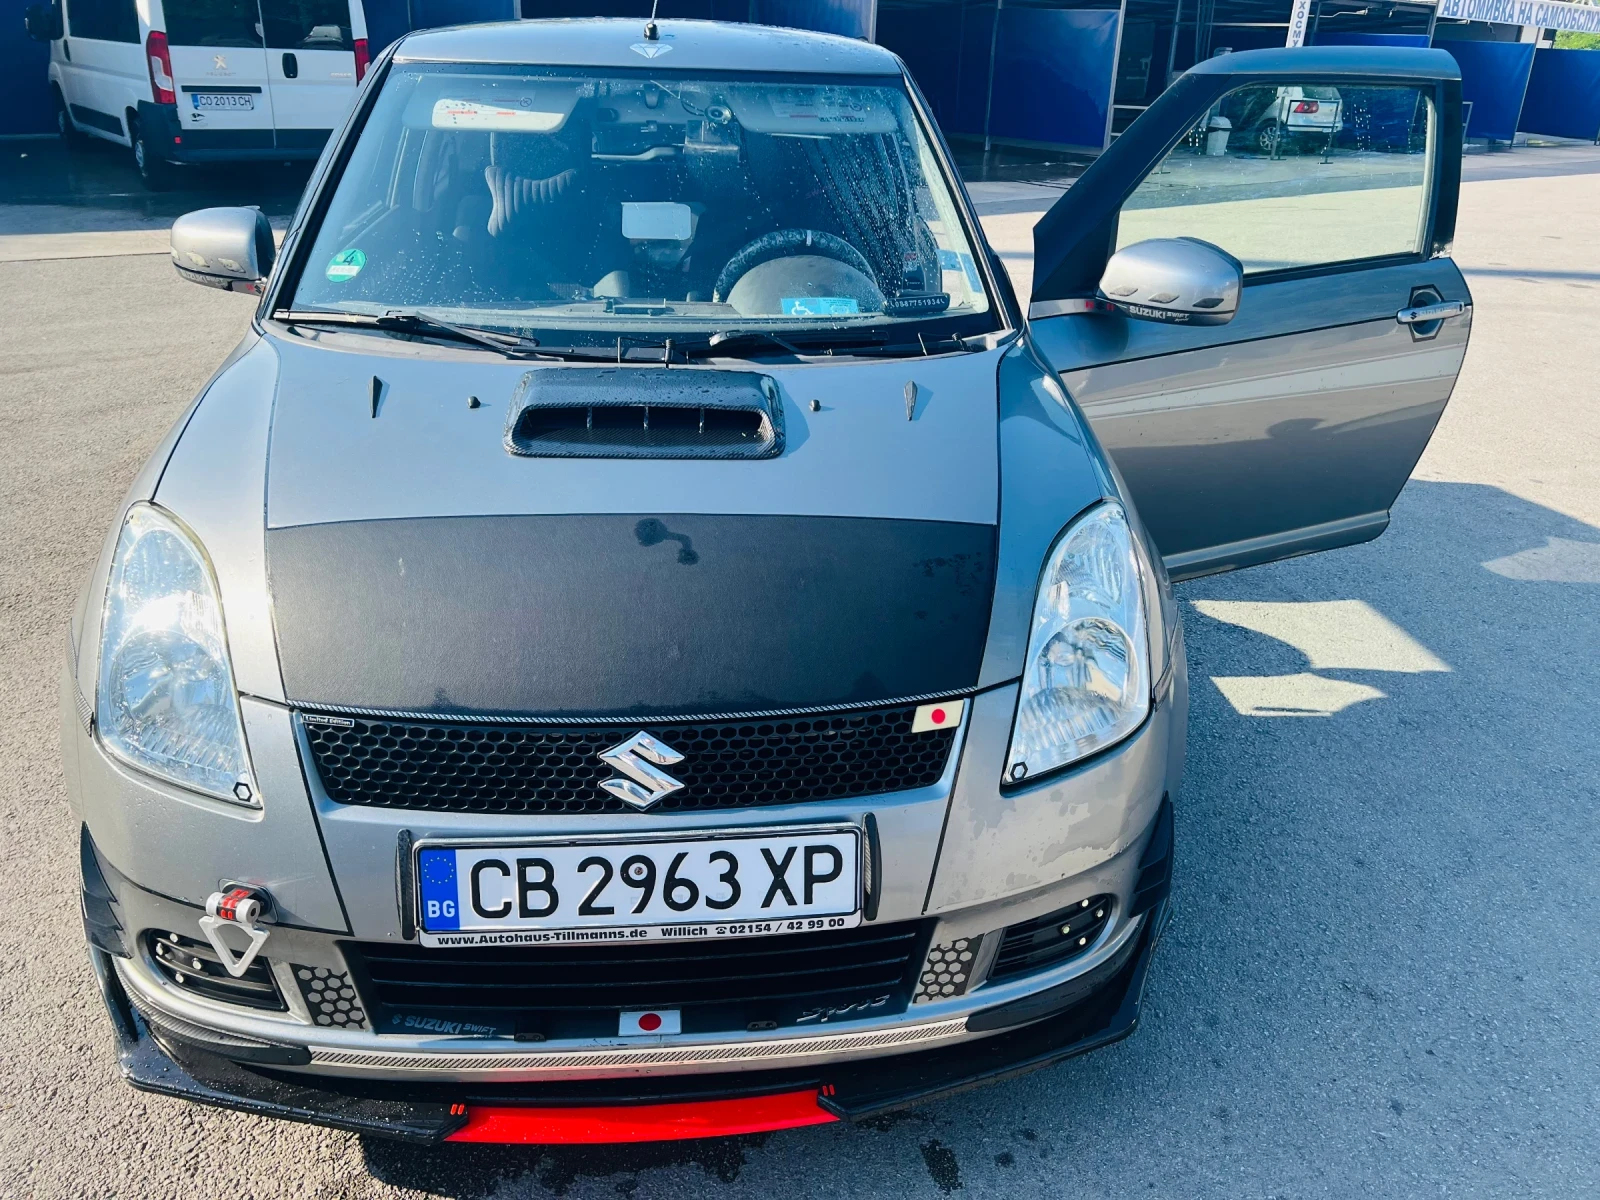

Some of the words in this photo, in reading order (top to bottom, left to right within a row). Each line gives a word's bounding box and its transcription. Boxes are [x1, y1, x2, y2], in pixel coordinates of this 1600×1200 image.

[1517, 2, 1533, 24] НА
[199, 96, 212, 105] CO
[214, 96, 237, 105] 2013
[238, 96, 251, 106] CH
[1129, 305, 1166, 319] SUZUKI
[1166, 311, 1190, 319] SWIFT
[329, 718, 351, 726] Edition
[470, 857, 559, 919] CB
[576, 850, 742, 917] 2963
[759, 844, 843, 909] XP
[427, 899, 456, 918] BG
[437, 928, 648, 945] www.Autohaus-Tillmanns.de
[661, 926, 708, 937] Willich
[787, 921, 803, 931] 42
[807, 919, 824, 929] 99
[828, 917, 845, 928] 00
[404, 1014, 462, 1034] SUZUKI
[463, 1023, 496, 1034] SWIFT
